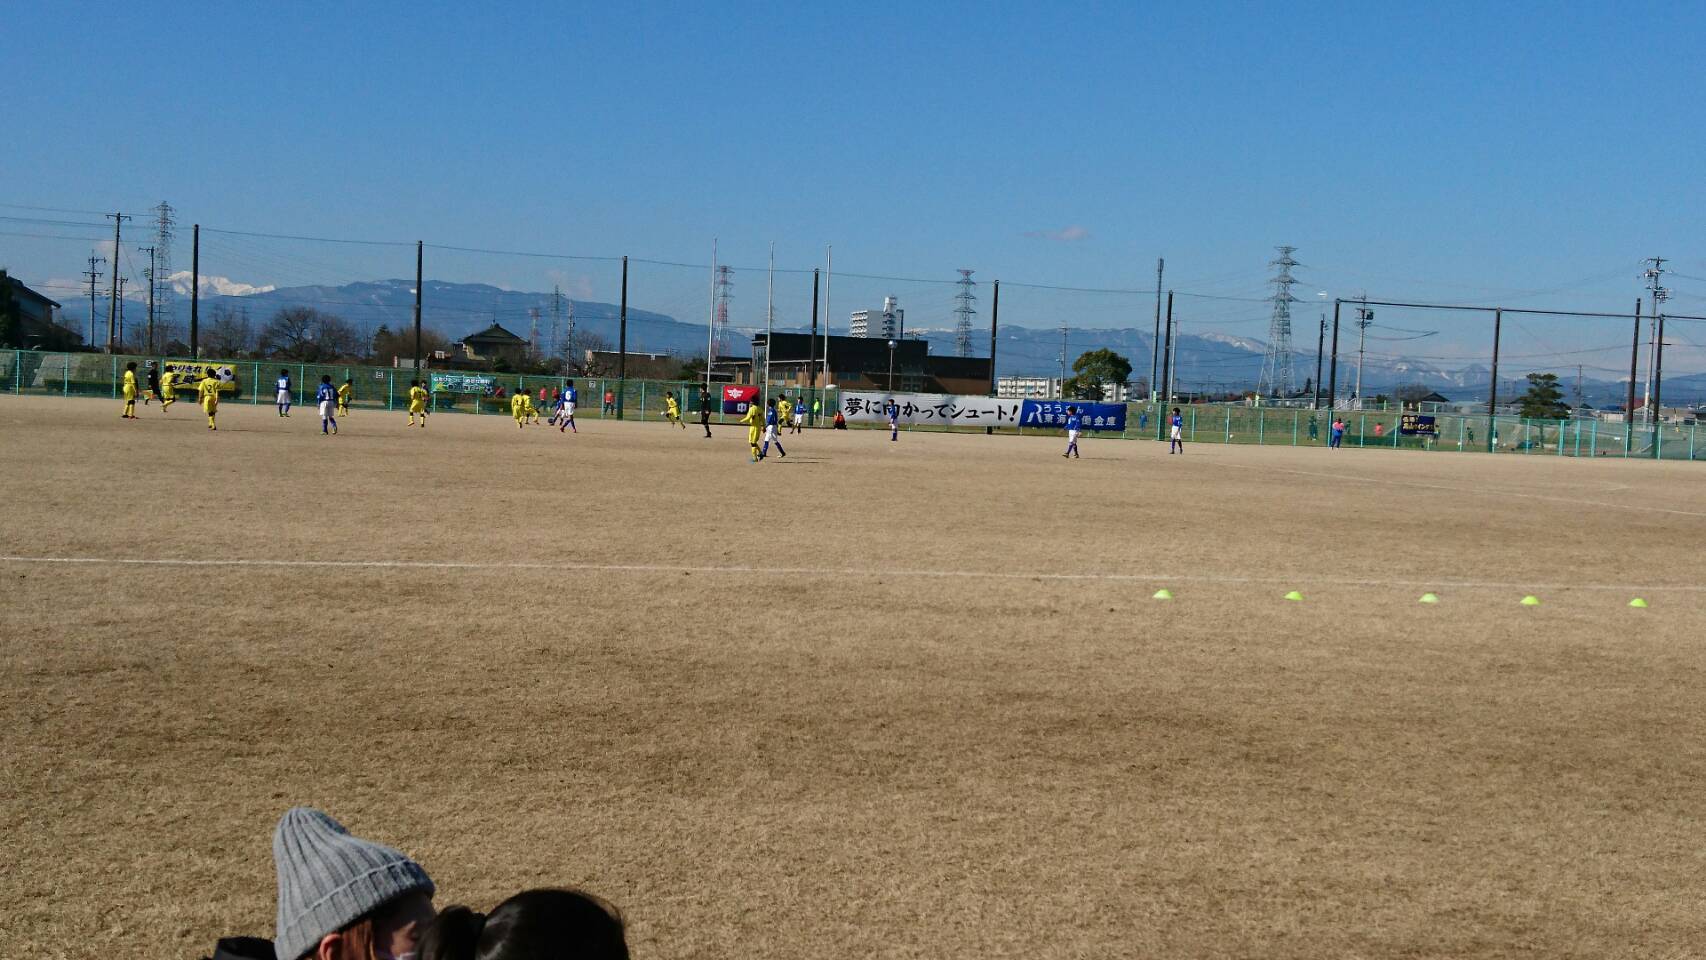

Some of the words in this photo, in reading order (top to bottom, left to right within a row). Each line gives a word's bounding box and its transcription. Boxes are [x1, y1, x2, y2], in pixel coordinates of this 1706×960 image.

[207, 384, 213, 393] 2
[1043, 403, 1084, 414] ろうん
[1043, 413, 1117, 427] 東海働金庫
